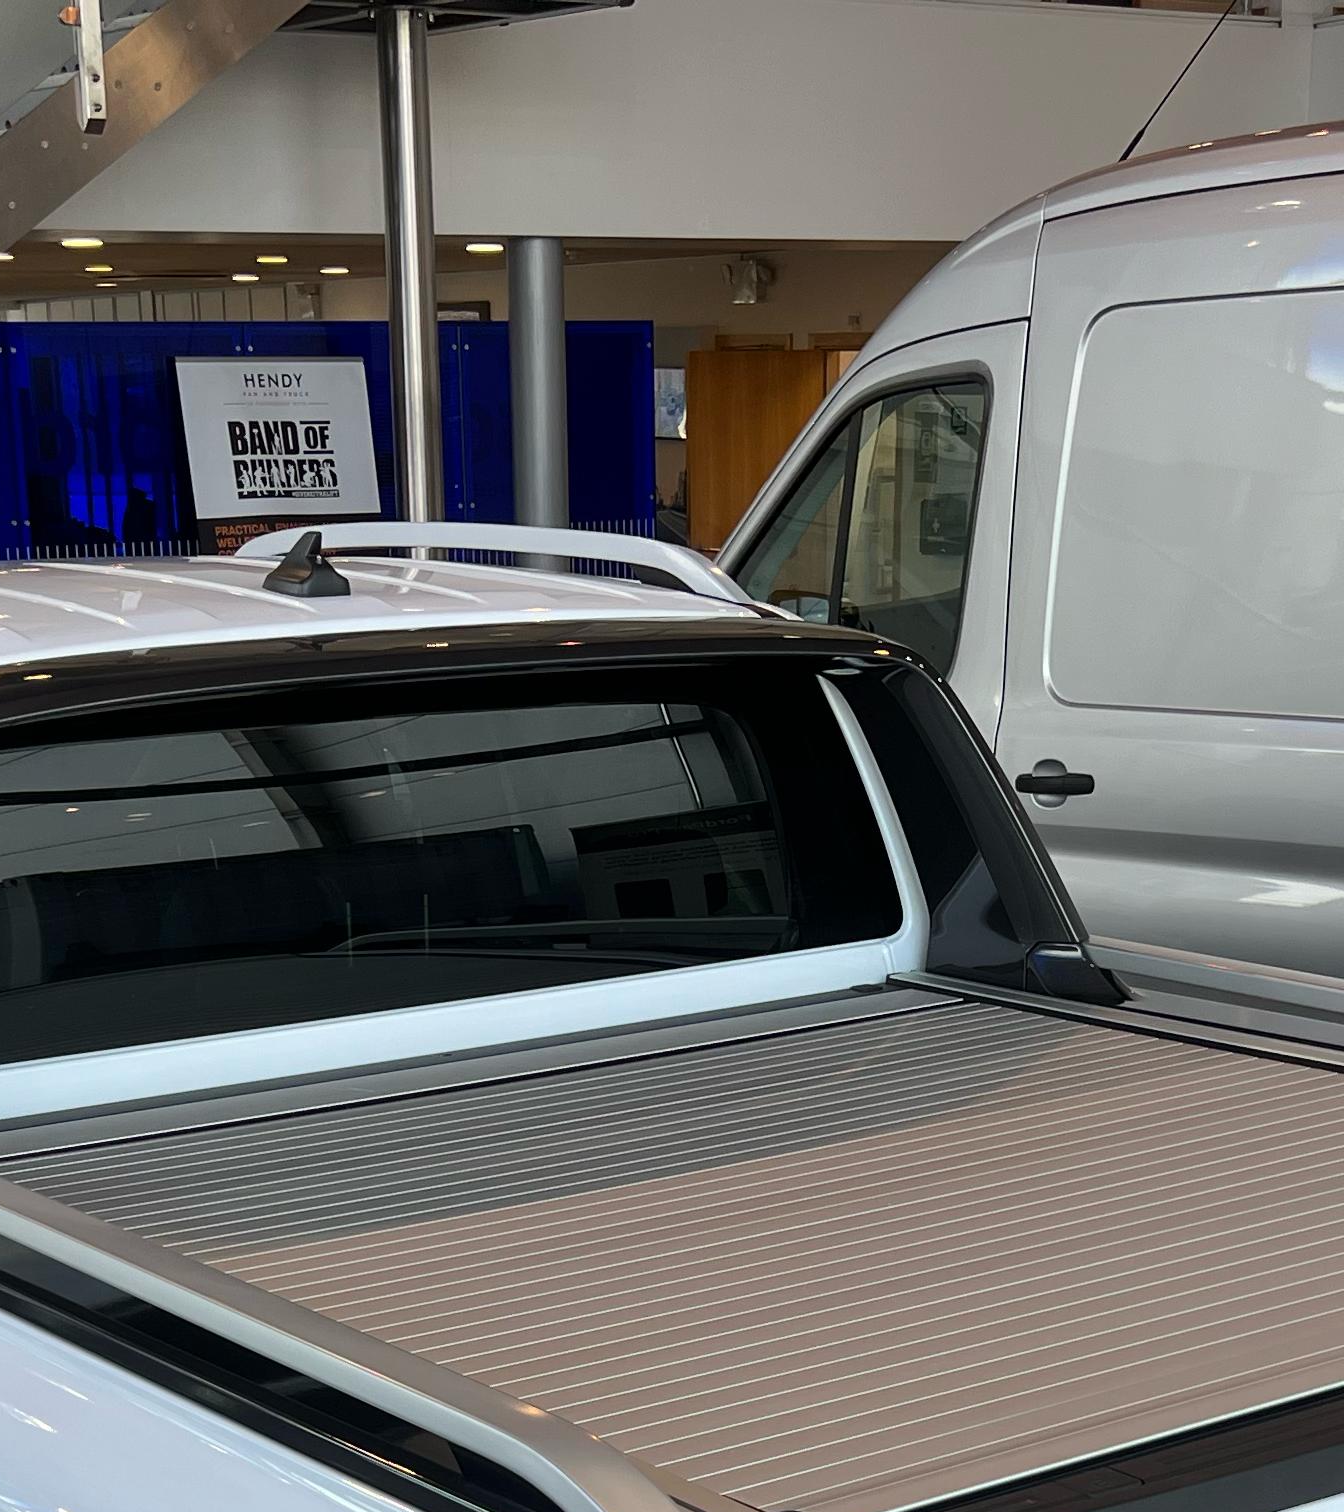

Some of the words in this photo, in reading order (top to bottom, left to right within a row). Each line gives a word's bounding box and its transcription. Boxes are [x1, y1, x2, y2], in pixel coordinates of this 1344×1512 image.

[243, 373, 302, 388] HENDY
[227, 420, 300, 455] BAND
[303, 425, 330, 449] OF
[232, 458, 338, 489] BUILDERS
[215, 523, 271, 536] PRACTICAL
